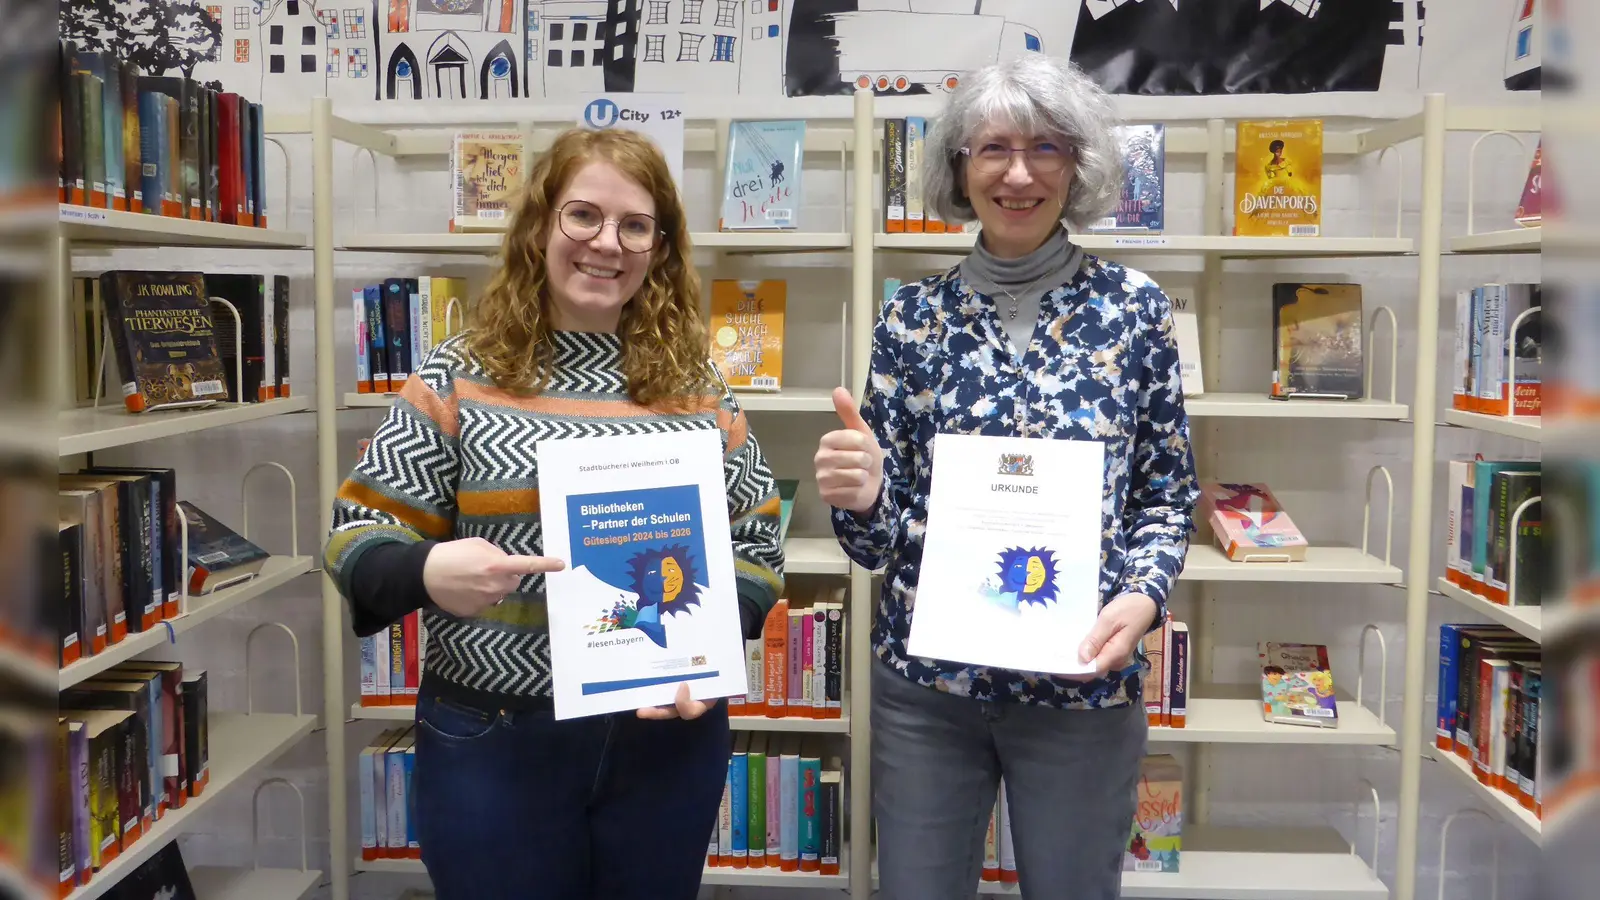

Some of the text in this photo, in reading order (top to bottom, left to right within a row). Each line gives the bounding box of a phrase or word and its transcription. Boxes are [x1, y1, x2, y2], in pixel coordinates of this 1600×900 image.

[619, 108, 650, 123] City
[660, 108, 682, 121] 12+
[481, 147, 518, 170] Morgen
[486, 177, 507, 191] dich
[733, 175, 763, 198] drei
[1274, 186, 1284, 195] DIE
[1239, 192, 1317, 214] DAVENPORTS
[150, 284, 192, 297] ROWLING
[135, 308, 201, 317] PHANTASTISCHE
[737, 300, 756, 312] DIE
[124, 315, 214, 334] TIERWESEN
[725, 312, 764, 325] SUCHE
[1482, 299, 1491, 336] Winter
[738, 324, 768, 337] NACH
[731, 364, 758, 376] FINK
[630, 459, 664, 469] Weilheim
[990, 483, 1039, 495] URKUNDE
[580, 501, 644, 516] Bibliotheken
[631, 516, 648, 527] der
[650, 511, 691, 526] Schulen
[583, 527, 691, 547] Gütesiegel 2024 bis 2026
[392, 623, 402, 674] MIDNIGHT SUN
[587, 635, 644, 649] #lesen.bayern
